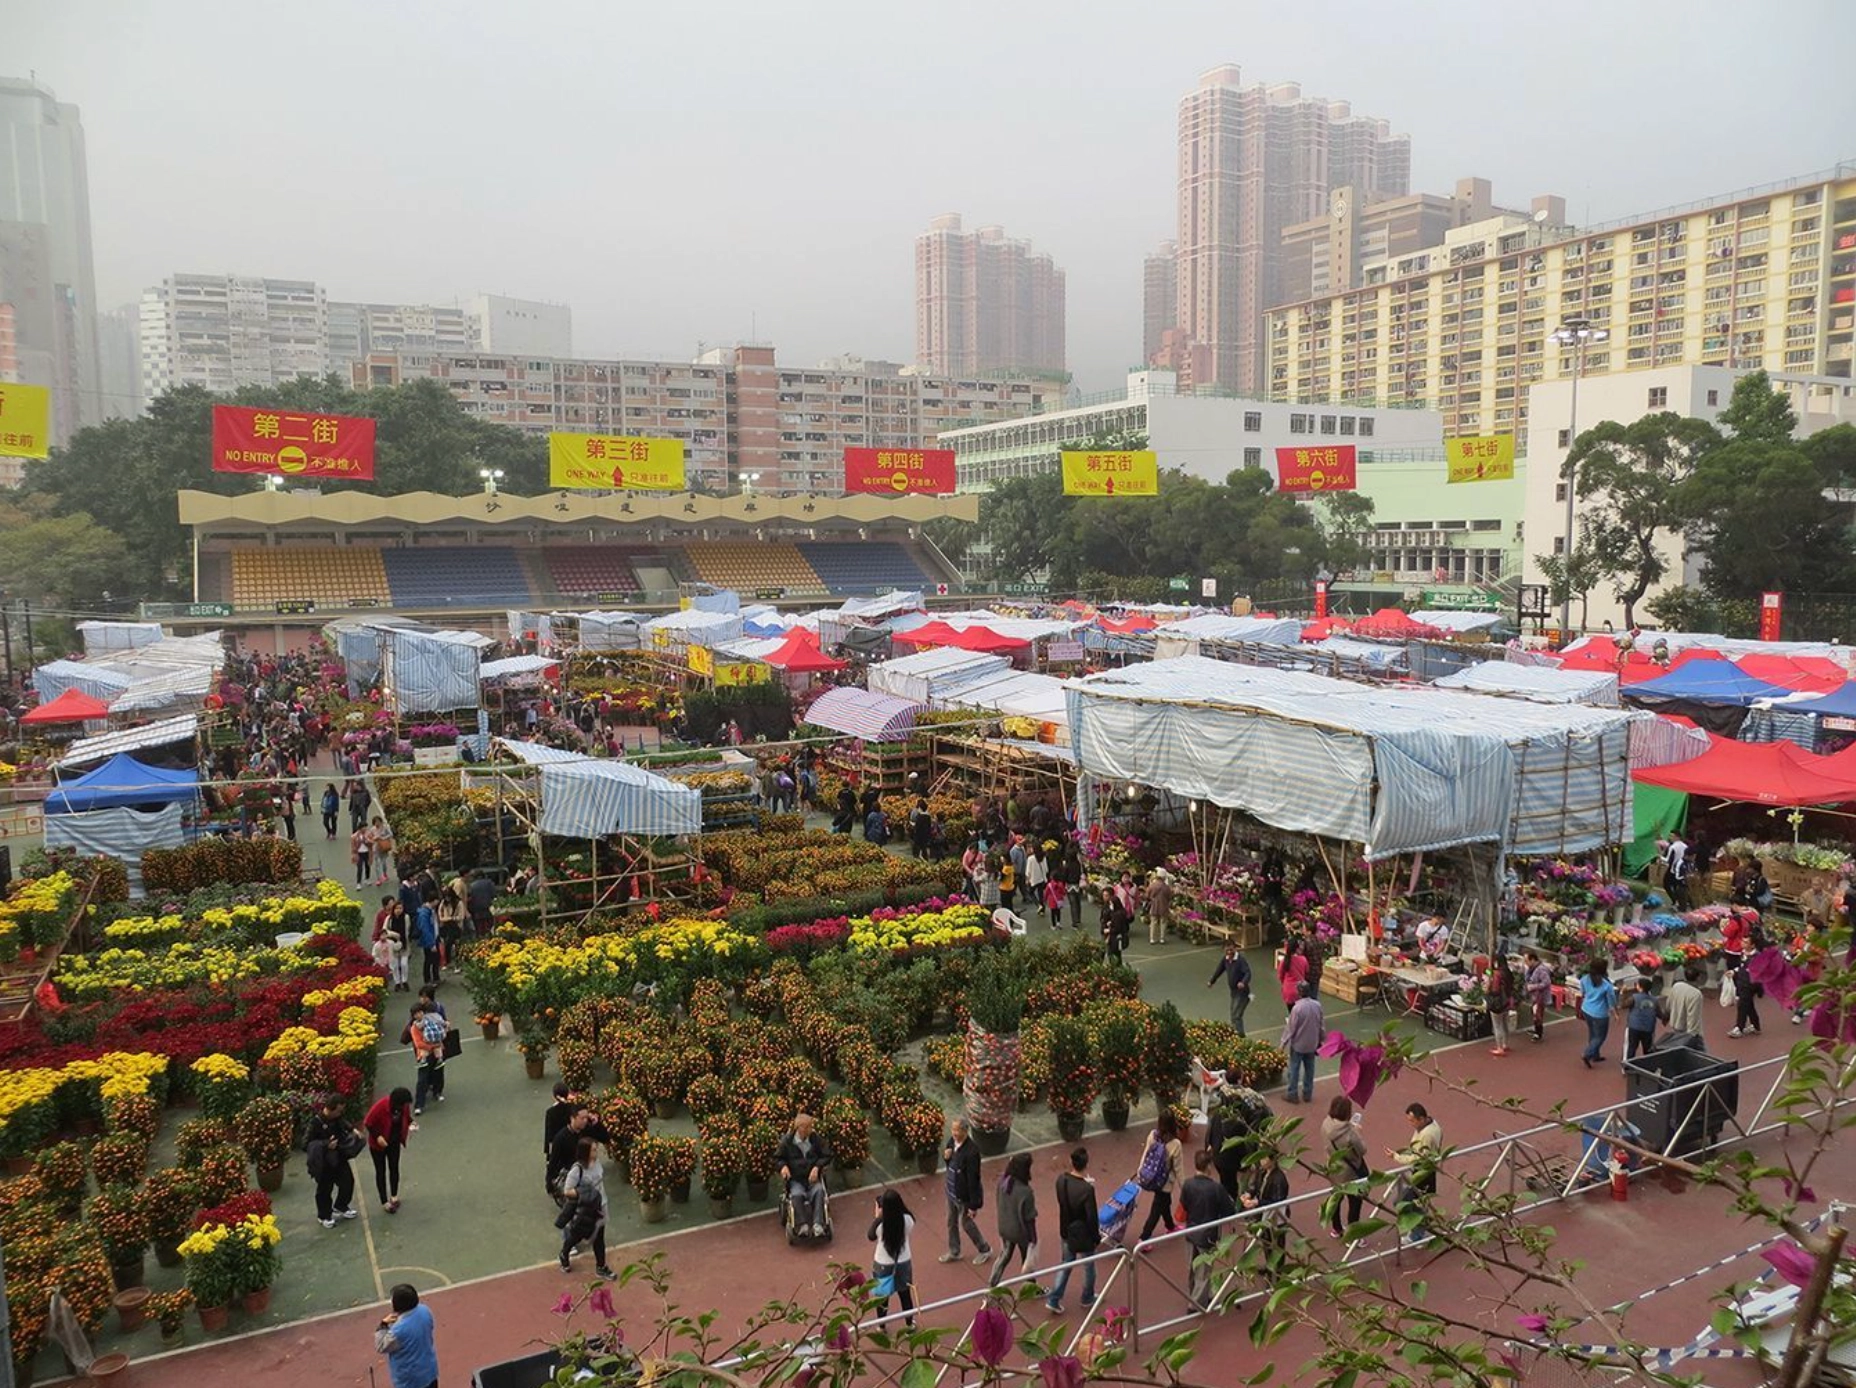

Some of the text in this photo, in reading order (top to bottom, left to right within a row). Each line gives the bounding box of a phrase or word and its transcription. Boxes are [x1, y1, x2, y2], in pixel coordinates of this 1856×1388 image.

[253, 413, 339, 444] 第二街
[225, 449, 275, 464] NO ENTRY
[586, 438, 650, 462] 第三街
[1295, 449, 1339, 467] 第六街
[1461, 440, 1499, 458] 第七街
[877, 451, 925, 470] 第四街
[1086, 454, 1133, 472] 第五街
[566, 468, 607, 479] ONE WAY
[1023, 584, 1044, 592] EXIT
[201, 605, 215, 615] EXIT
